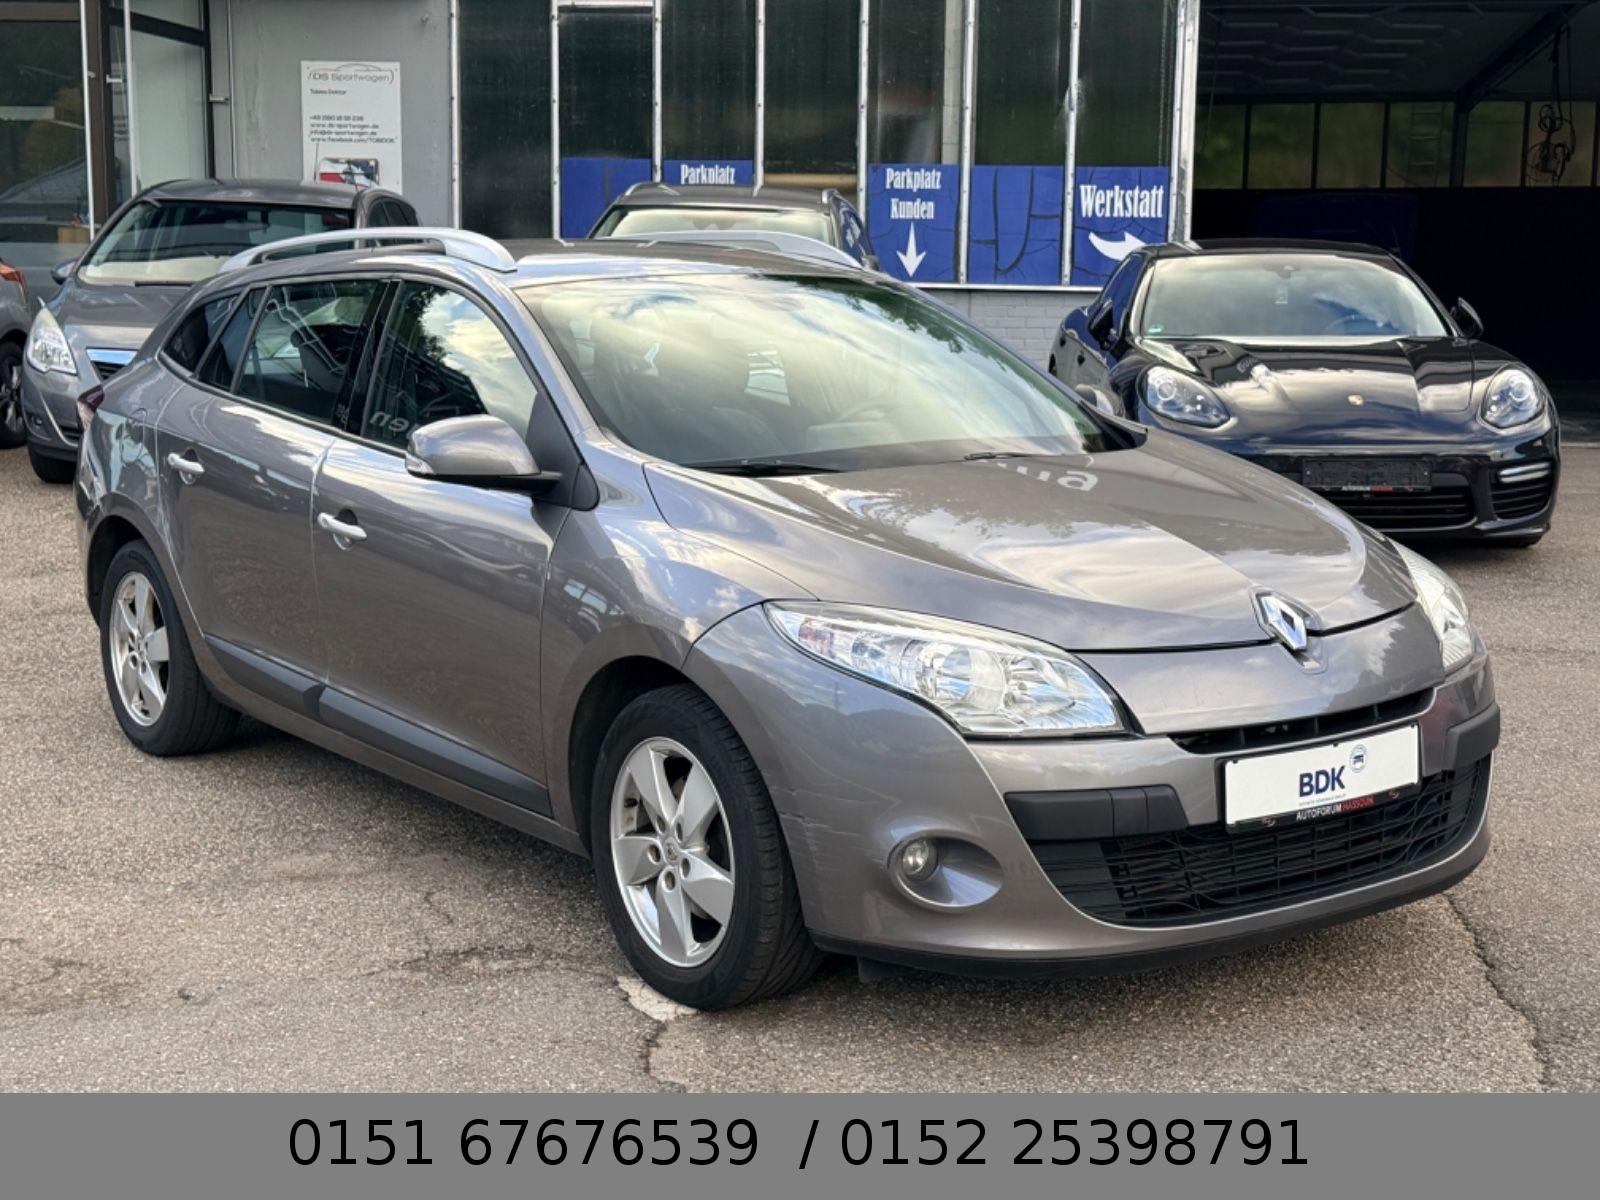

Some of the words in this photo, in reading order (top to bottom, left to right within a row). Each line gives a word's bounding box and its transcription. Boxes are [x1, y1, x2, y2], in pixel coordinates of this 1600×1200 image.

[680, 164, 736, 185] Parkplatz
[885, 167, 942, 192] Parkplatz
[890, 197, 935, 220] Kunden
[1079, 184, 1165, 218] Werkstatt
[1298, 764, 1346, 798] BDK
[1296, 802, 1343, 821] AUTOFORUM
